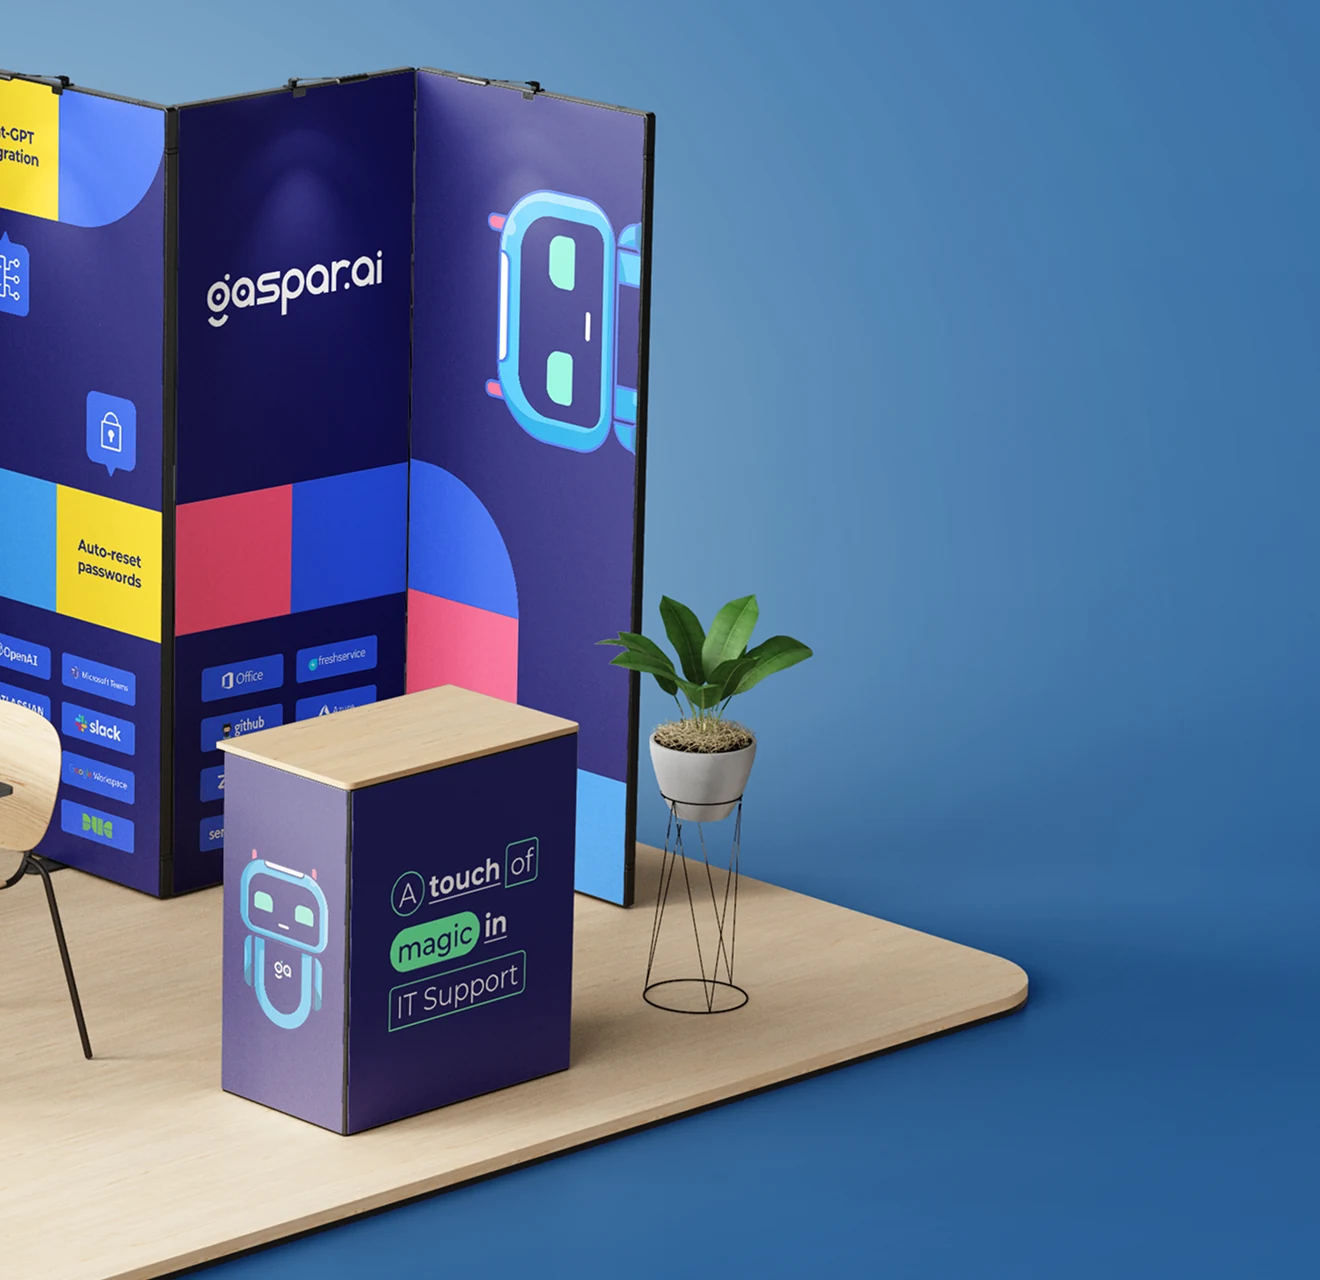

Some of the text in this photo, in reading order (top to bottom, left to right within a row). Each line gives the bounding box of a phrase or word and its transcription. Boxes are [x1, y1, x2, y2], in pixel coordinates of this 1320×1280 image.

[206, 250, 383, 328] gaspar.ai
[77, 539, 142, 569] Auto-reset
[77, 561, 142, 588] passwords
[3, 646, 38, 667] OpenAI
[318, 648, 366, 666] freshservice
[81, 671, 129, 692] Microsoft Teams
[235, 670, 264, 685] Office
[89, 719, 121, 742] slack
[234, 715, 265, 737] github
[68, 763, 128, 790] Google Workspace
[398, 846, 535, 908] A touch of
[398, 912, 507, 964] magic in
[397, 964, 519, 1019] IT Support
